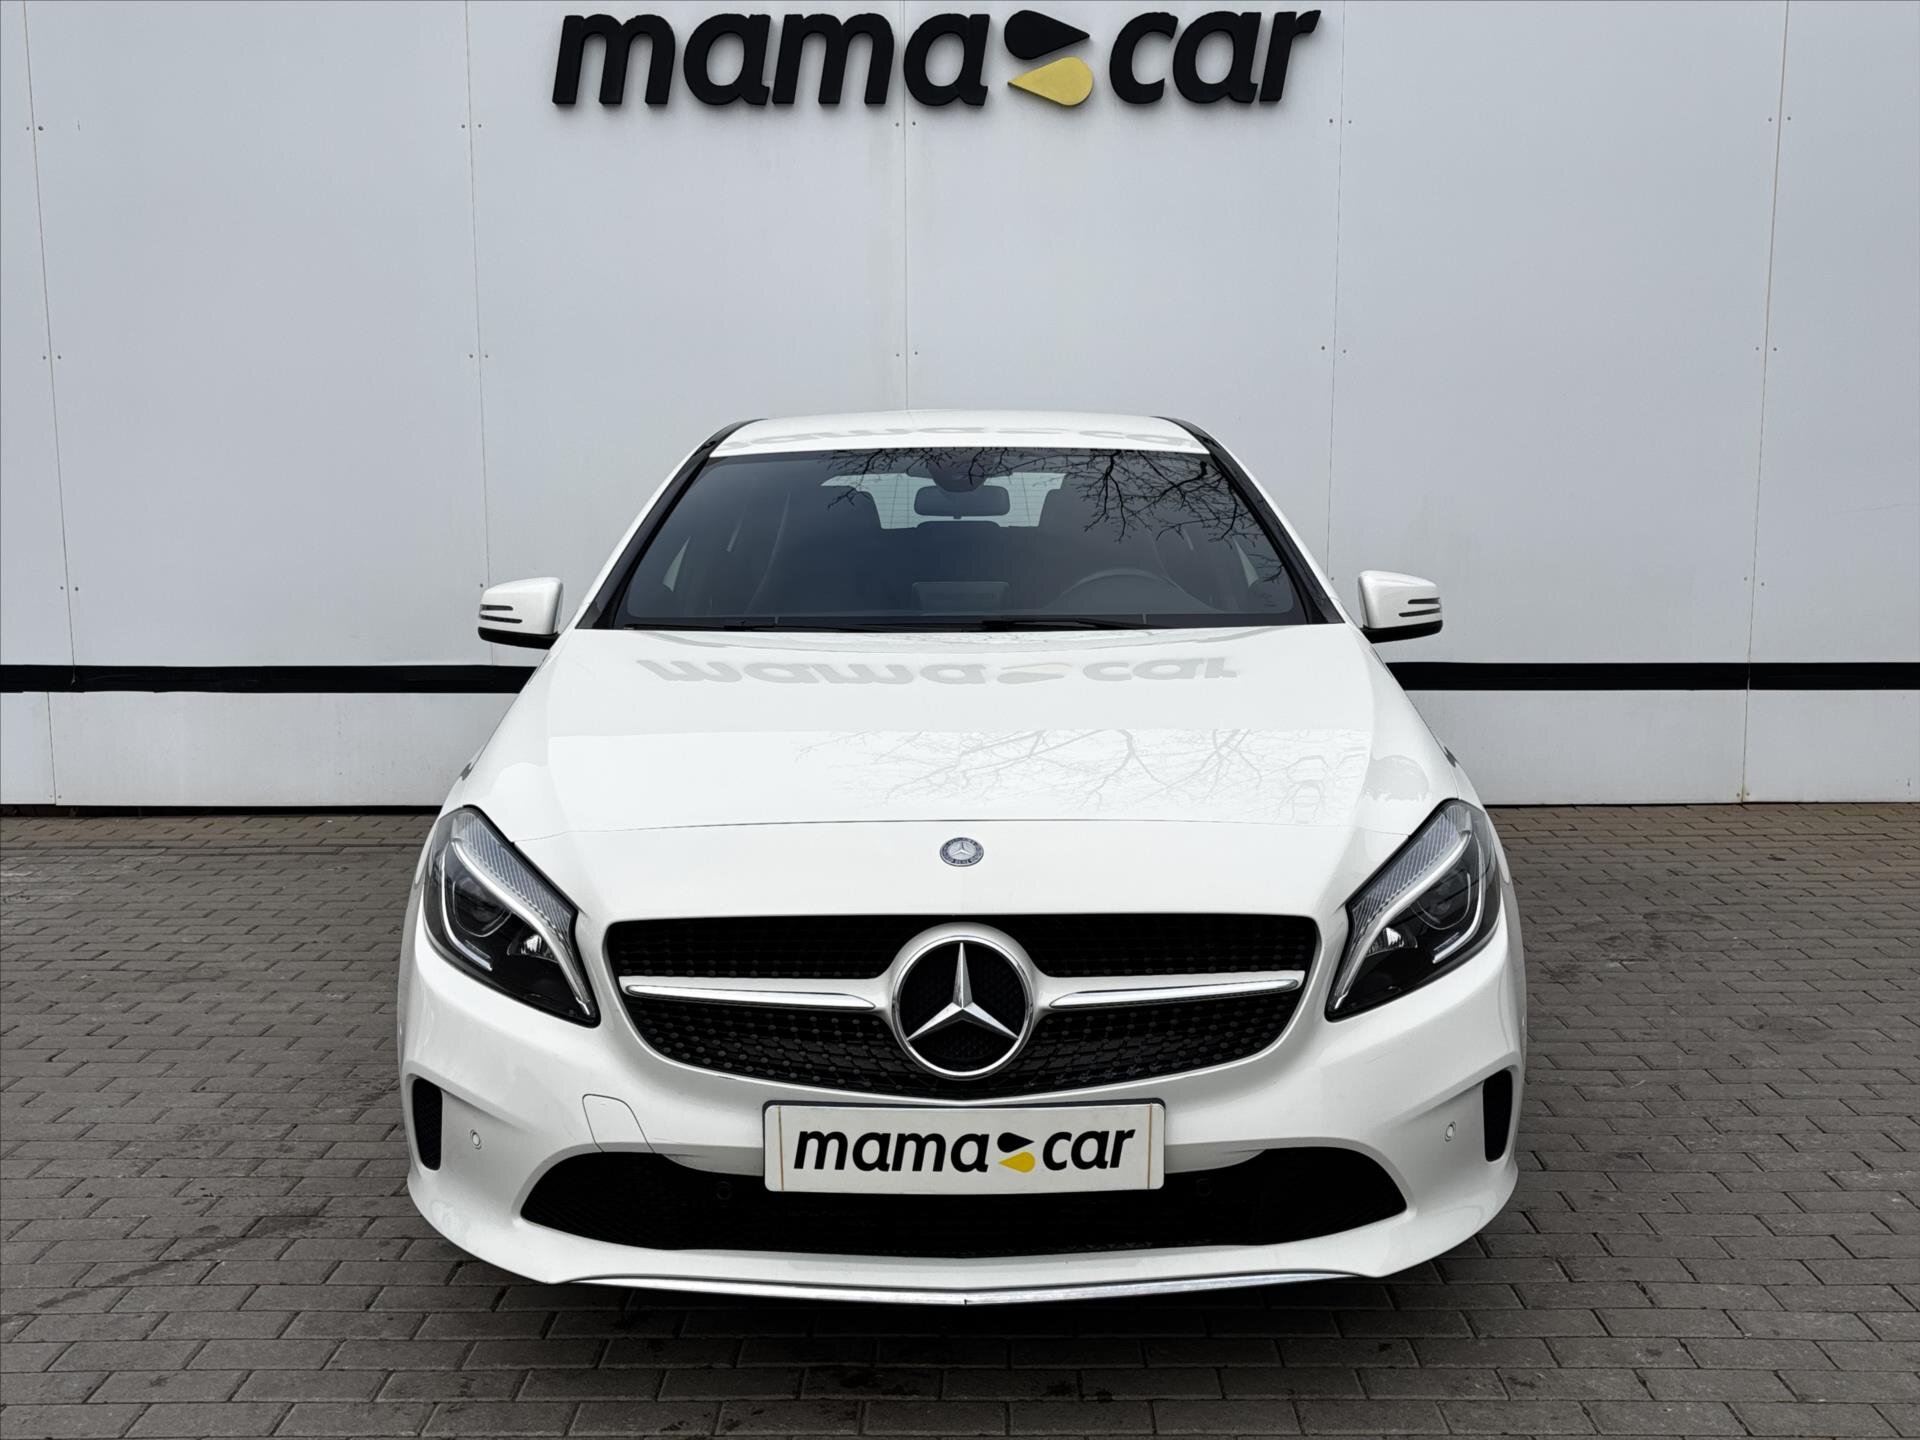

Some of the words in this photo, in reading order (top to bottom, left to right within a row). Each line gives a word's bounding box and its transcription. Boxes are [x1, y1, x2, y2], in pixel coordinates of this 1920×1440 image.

[553, 13, 989, 106] mama
[1110, 10, 1321, 105] car
[794, 1131, 989, 1172] mama
[1043, 1129, 1135, 1171] car
